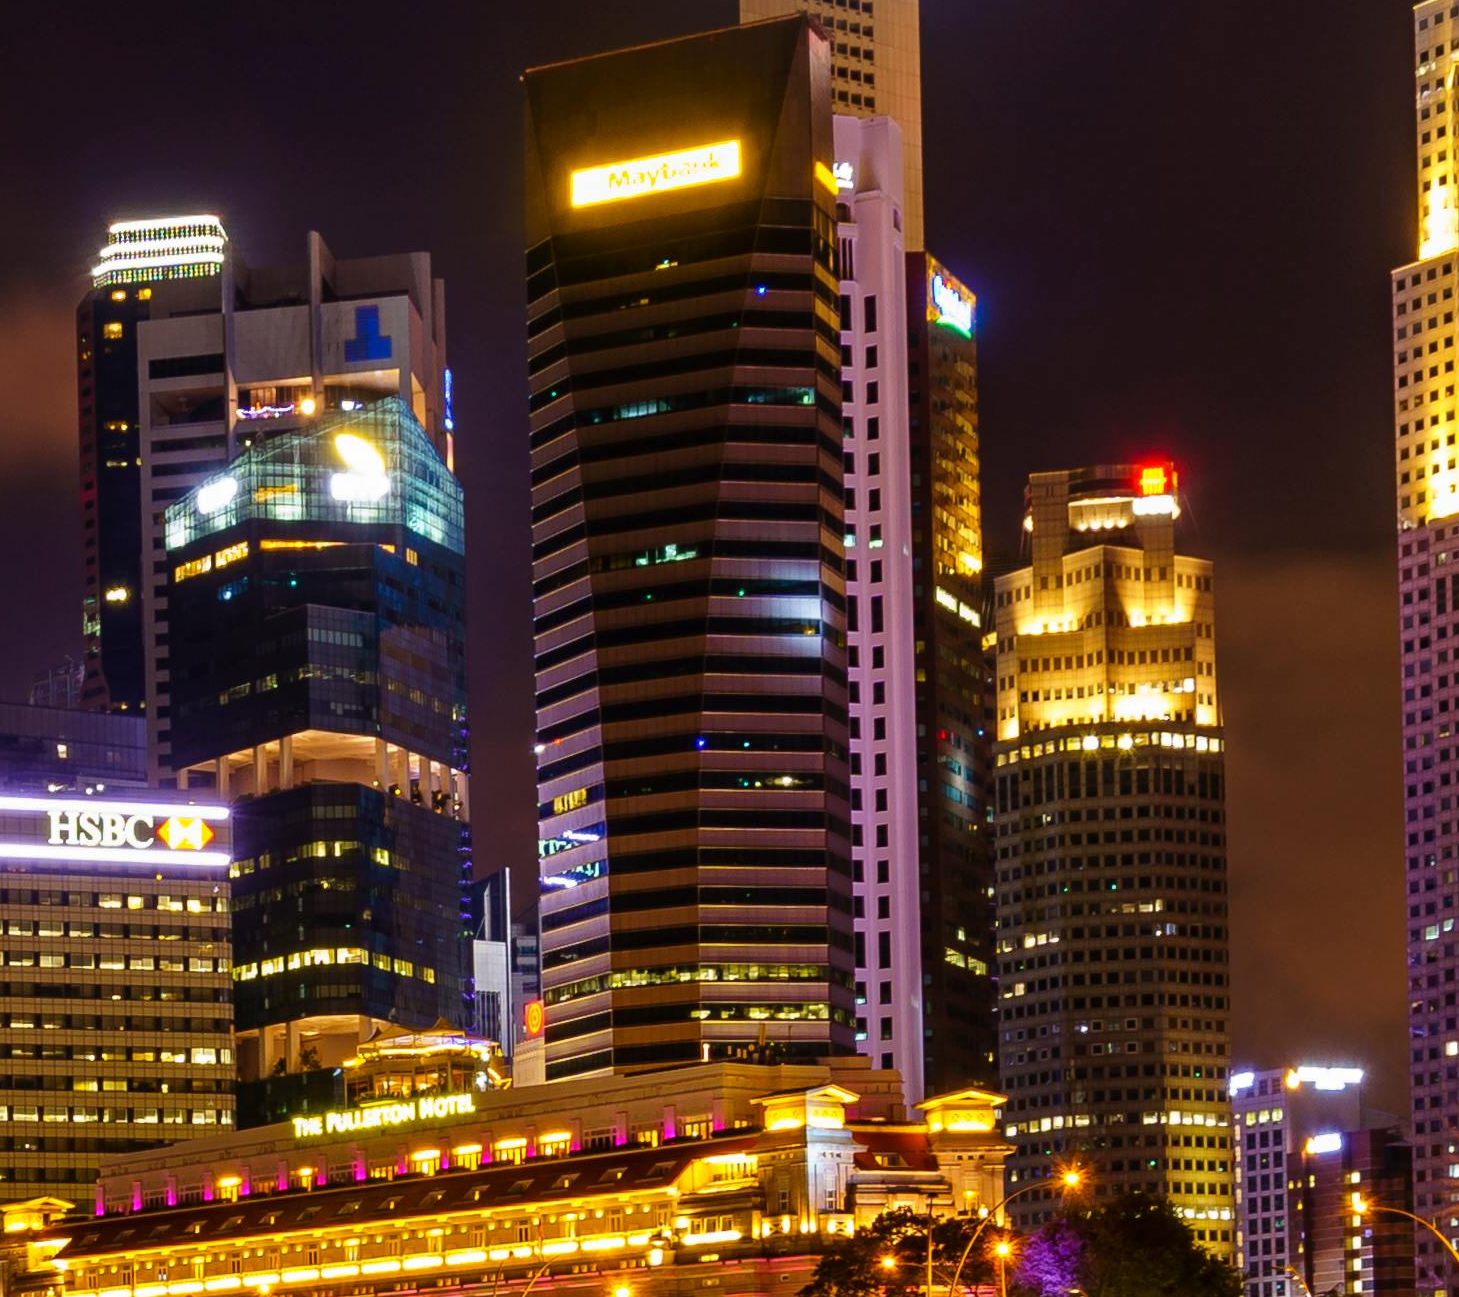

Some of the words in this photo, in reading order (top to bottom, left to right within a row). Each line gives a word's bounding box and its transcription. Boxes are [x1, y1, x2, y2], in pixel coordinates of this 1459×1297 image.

[47, 810, 155, 849] HSBC
[292, 1115, 323, 1138] THE
[326, 1102, 416, 1134] FULLERTON
[419, 1093, 477, 1120] HOTEL
